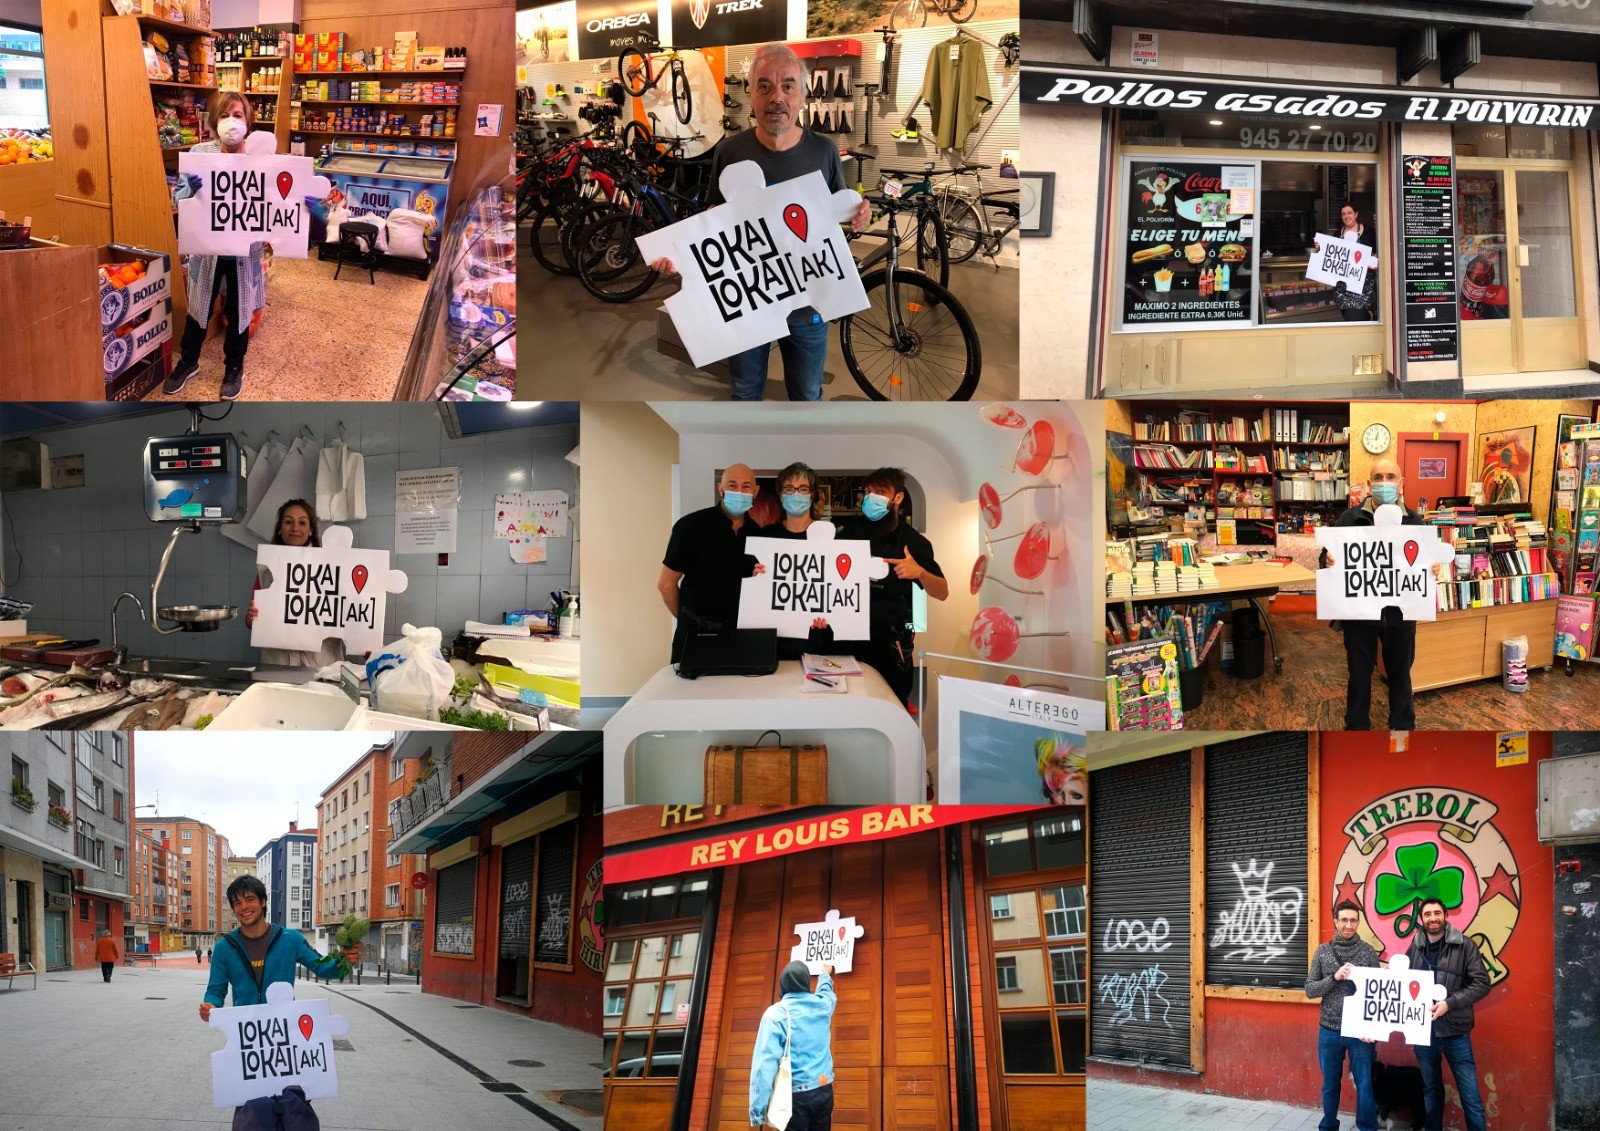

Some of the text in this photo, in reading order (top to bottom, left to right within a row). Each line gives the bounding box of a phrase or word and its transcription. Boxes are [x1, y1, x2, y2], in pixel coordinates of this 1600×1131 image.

[716, 0, 763, 14] TREK
[586, 12, 650, 33] ORBEA
[610, 36, 634, 47] moves
[1036, 78, 1594, 127] Pollos asados EL POLVORIN
[1240, 127, 1377, 153] 945 27 70 20
[211, 170, 265, 201] LOKAL
[1130, 230, 1177, 242] ELIGE
[1180, 230, 1199, 242] TU
[690, 217, 779, 283] LOKAL
[1325, 243, 1350, 262] LOKAL
[133, 278, 166, 304] BOLLO
[1134, 302, 1170, 310] MAXIMO
[1179, 301, 1240, 309] INGREDIENTES
[136, 320, 168, 349] BOLLO
[773, 553, 825, 582] LOKAL
[1343, 541, 1393, 569] LOKAL
[286, 562, 340, 595] LOKAL
[1350, 792, 1480, 842] TREBOL
[690, 805, 935, 866] REY LOUIS BAR
[808, 929, 834, 946] LOKAL
[1365, 978, 1401, 1001] LOKAL
[238, 1018, 290, 1050] LOKAL
